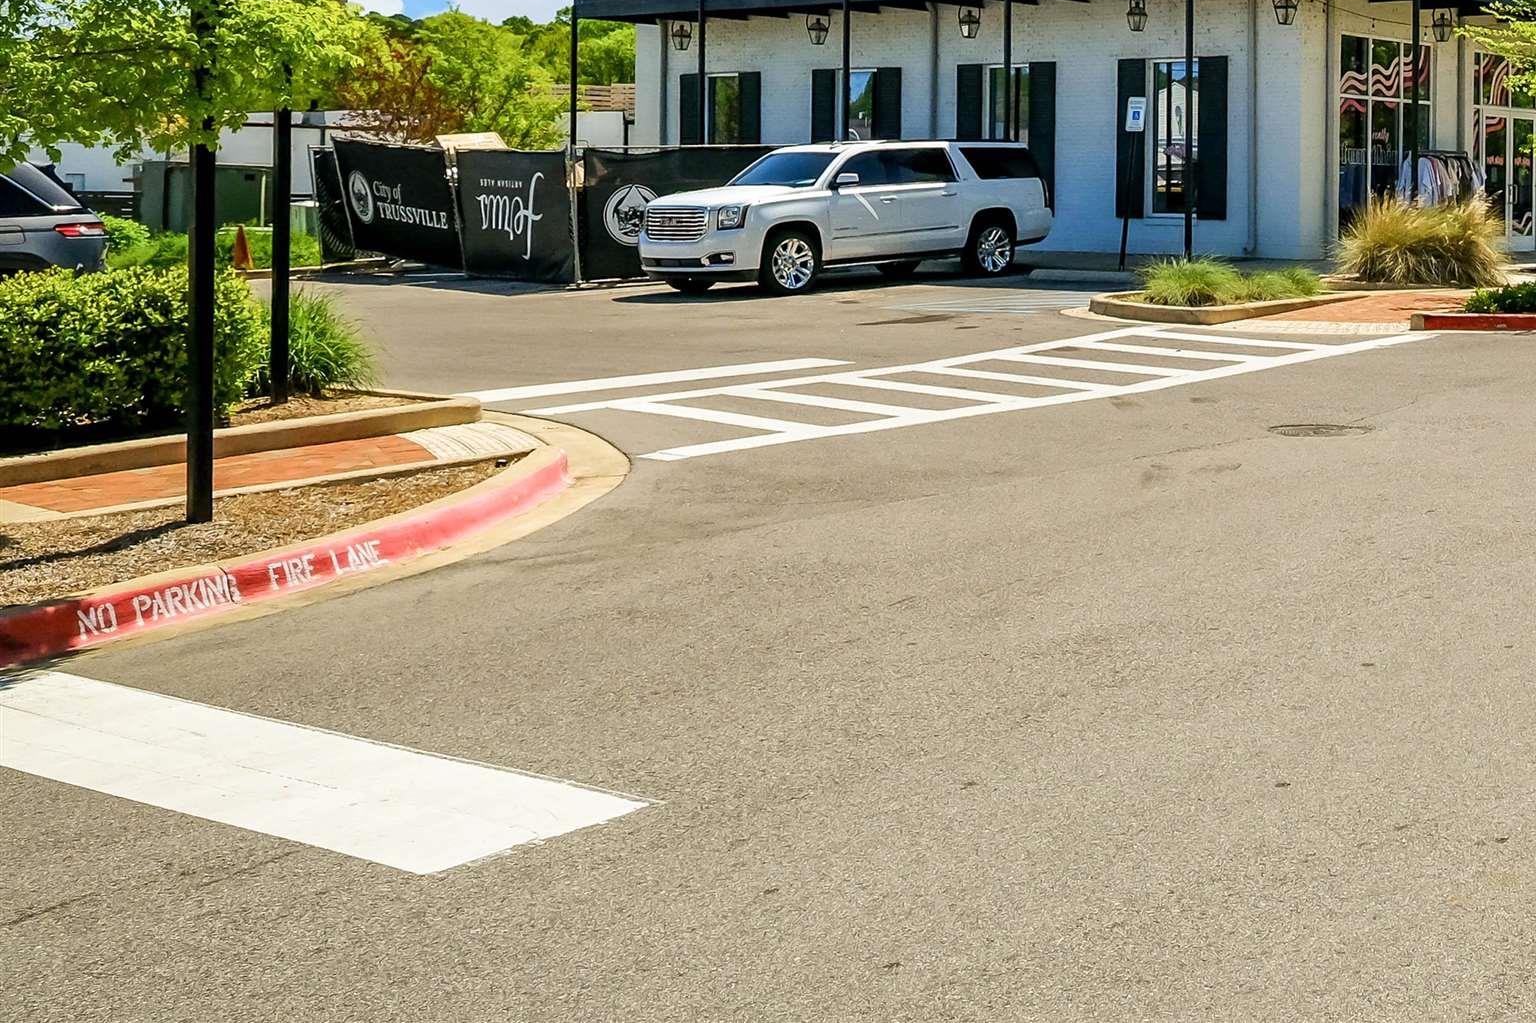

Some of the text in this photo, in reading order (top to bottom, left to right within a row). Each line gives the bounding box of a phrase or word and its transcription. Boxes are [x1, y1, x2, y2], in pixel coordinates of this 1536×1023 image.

[373, 180, 402, 204] City of
[376, 202, 449, 229] TRUSSVILLE
[77, 540, 391, 640] NO PARKING FIRE LANE
